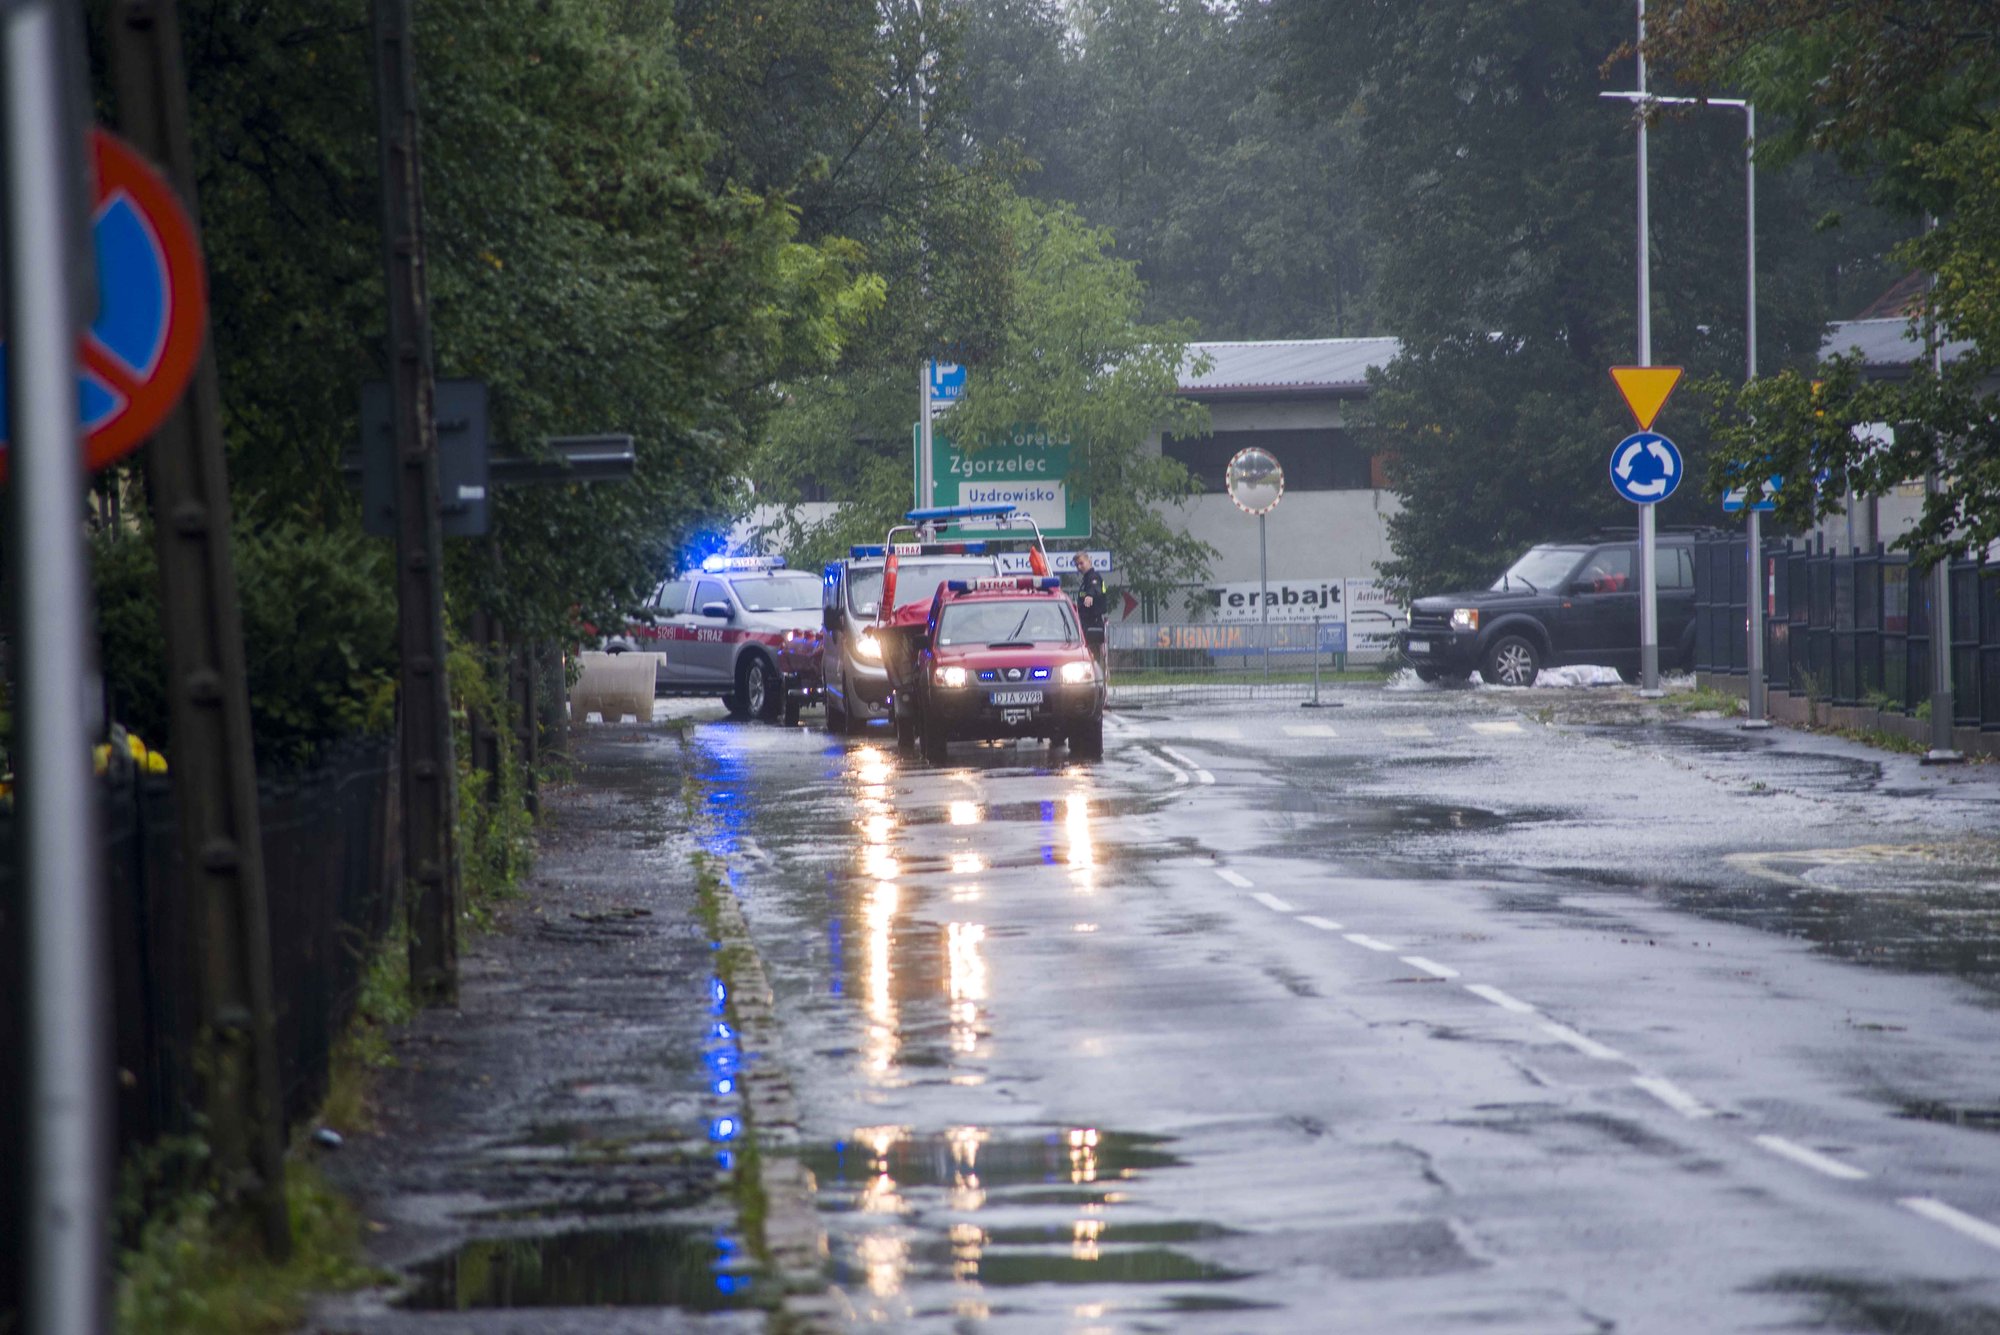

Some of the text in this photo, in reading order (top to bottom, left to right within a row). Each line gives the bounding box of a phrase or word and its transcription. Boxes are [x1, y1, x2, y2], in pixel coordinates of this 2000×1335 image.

[949, 455, 1047, 478] Zgorzelec
[969, 487, 1055, 502] Uzdrowisko
[1208, 583, 1341, 609] Terabajt
[996, 693, 1015, 704] DJA
